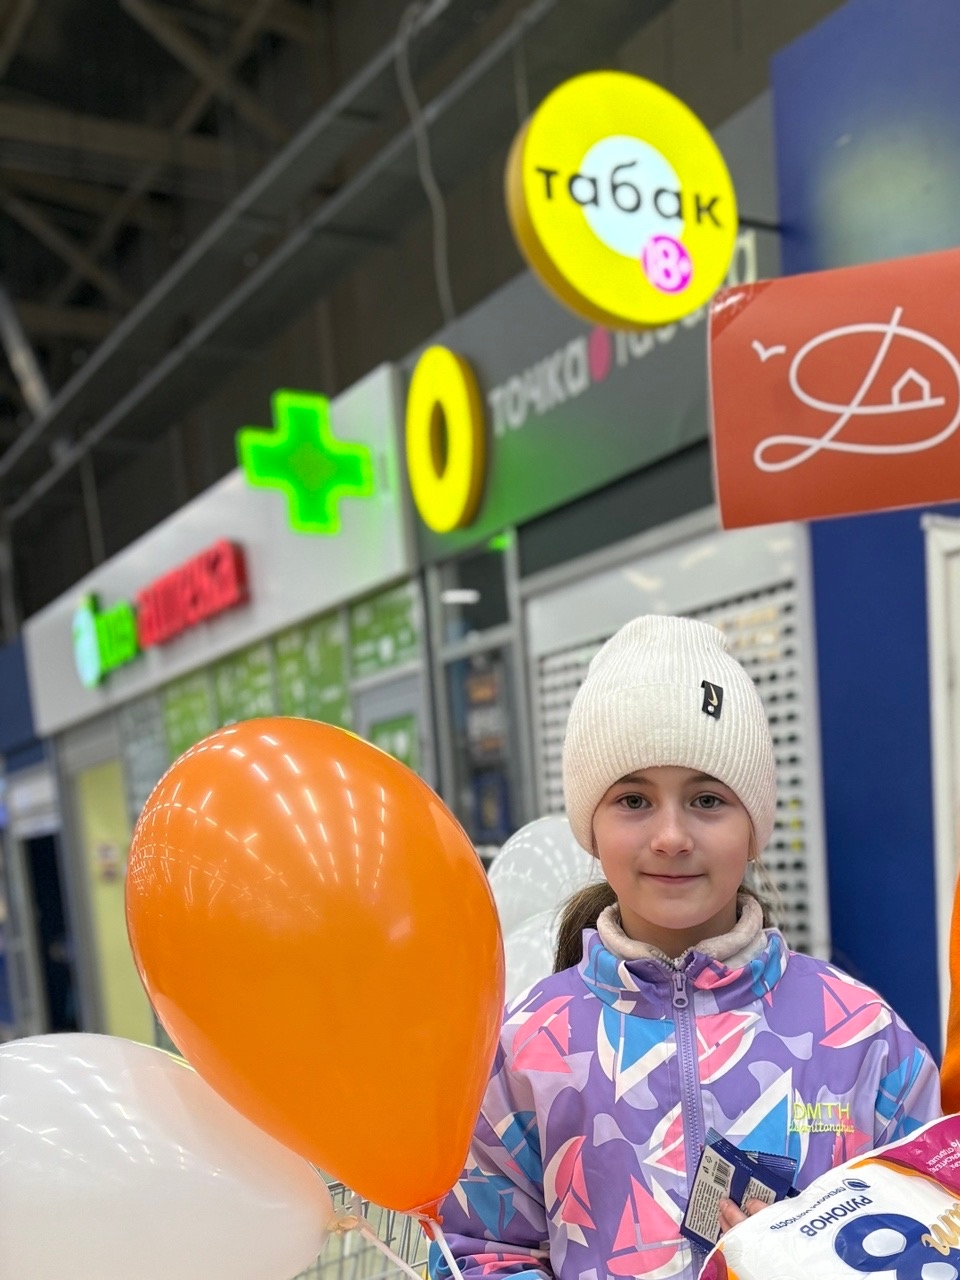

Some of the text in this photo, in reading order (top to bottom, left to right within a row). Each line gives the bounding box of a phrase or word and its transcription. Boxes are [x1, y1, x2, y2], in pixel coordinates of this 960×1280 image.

[535, 159, 722, 228] табак
[793, 1102, 851, 1121] DMTH
[800, 1194, 874, 1238] РУЛОНОВ
